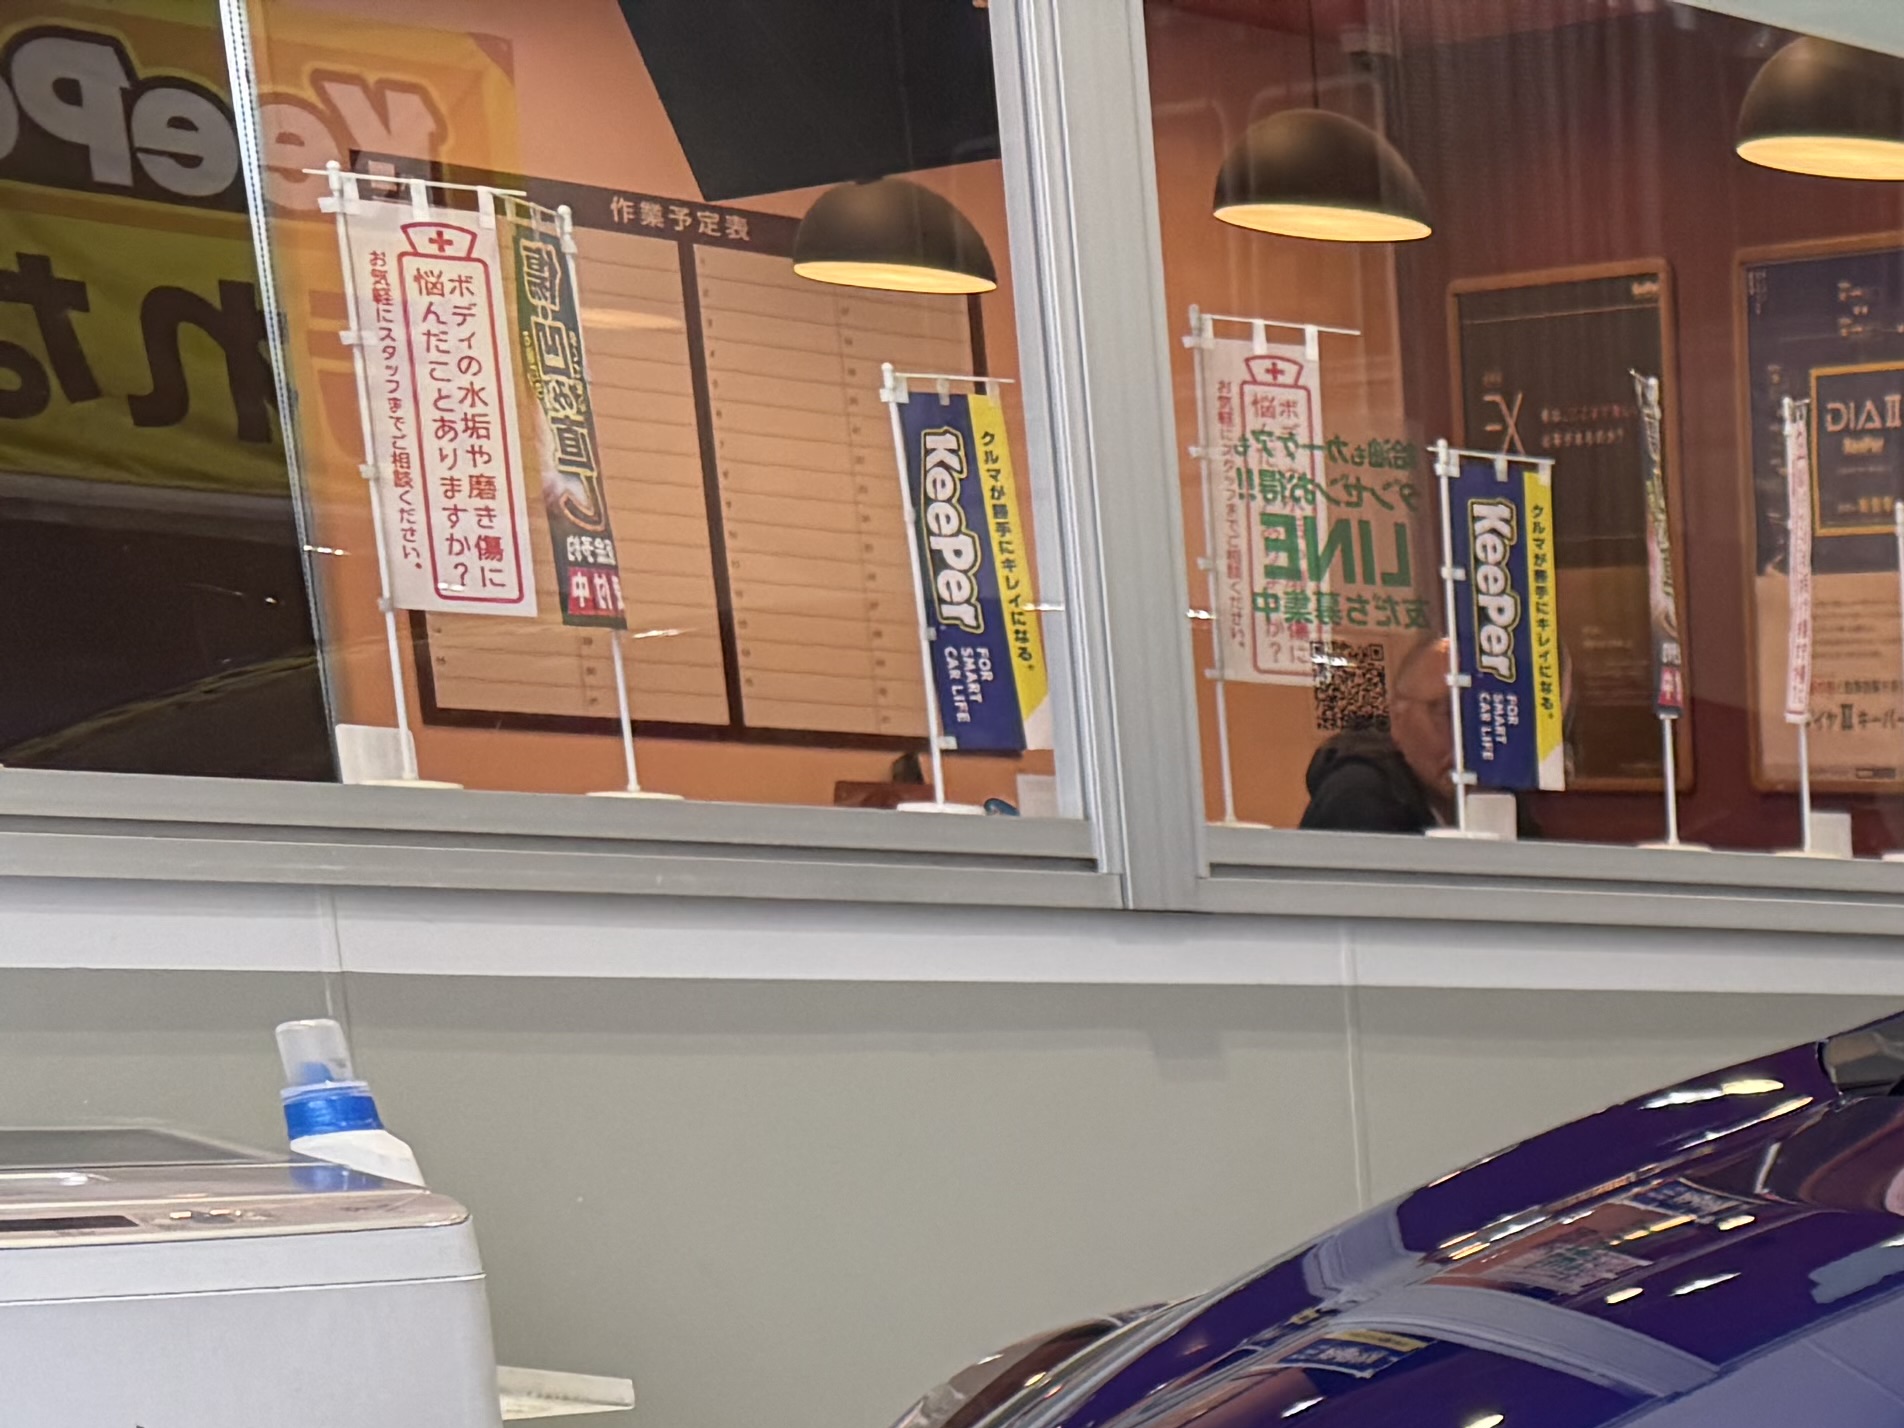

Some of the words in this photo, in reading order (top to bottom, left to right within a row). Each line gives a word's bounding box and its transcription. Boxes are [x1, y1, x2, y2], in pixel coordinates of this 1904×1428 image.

[610, 195, 750, 242] 作業予定表
[412, 267, 472, 587] 悩んだことありますか?
[449, 273, 506, 588] ボディの水垢や磨き傷に
[923, 428, 984, 634] KeePer
[1468, 498, 1521, 683] KeePer
[944, 646, 960, 679] CAR
[960, 646, 983, 704] SMART
[976, 647, 994, 682] FOR
[951, 684, 971, 724] LIFE
